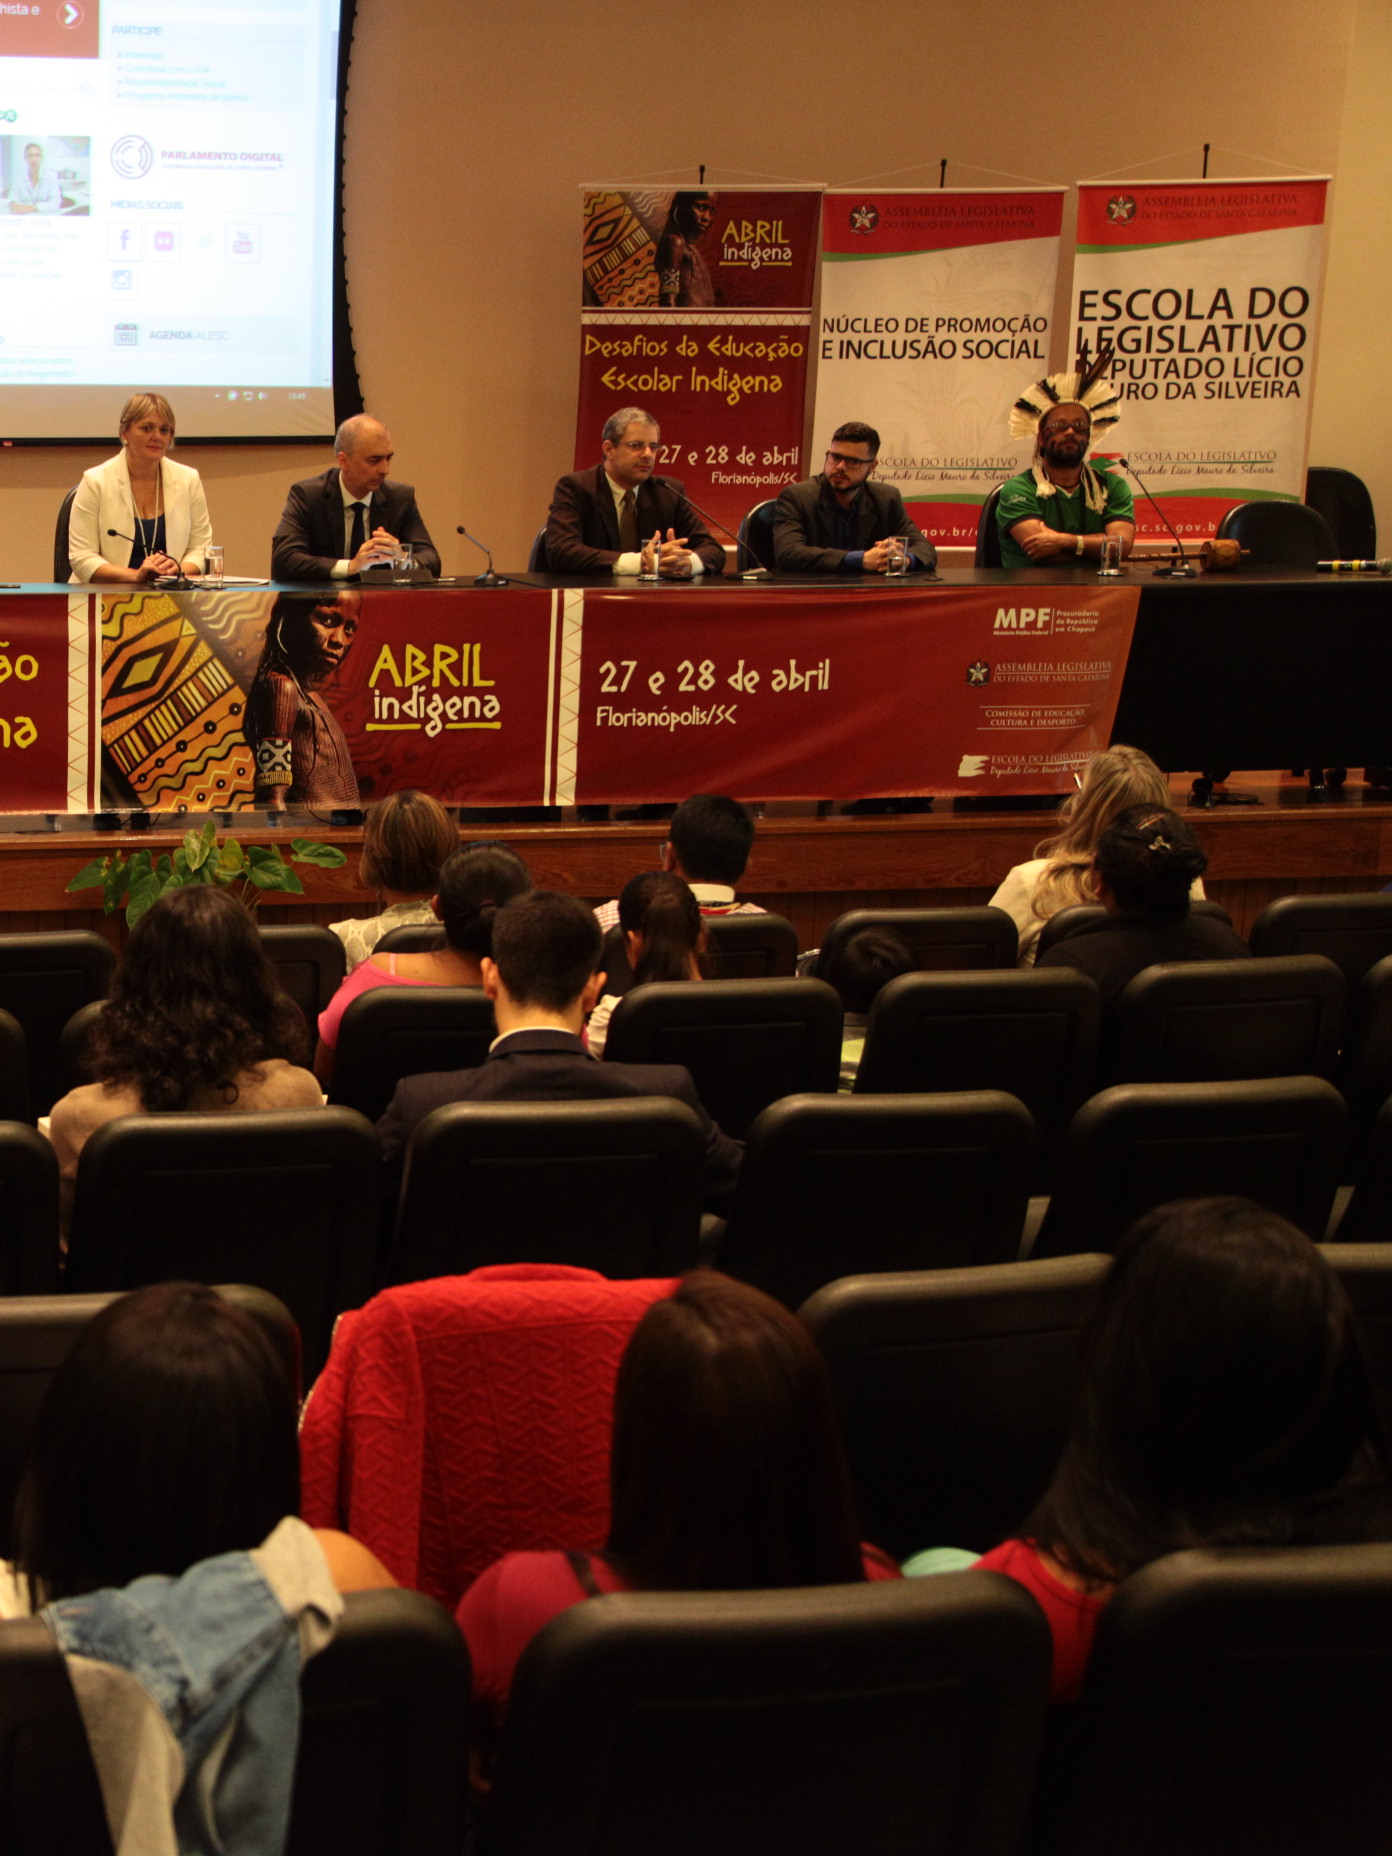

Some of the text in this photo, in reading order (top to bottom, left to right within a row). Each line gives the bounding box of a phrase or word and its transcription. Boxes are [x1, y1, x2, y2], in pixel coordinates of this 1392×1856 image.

[31, 6, 40, 14] e
[112, 25, 163, 36] PARTICIPE
[160, 150, 284, 162] PARLAMENTO DIGITAL
[110, 199, 184, 210] MÍDIAS SOCIAIS
[1144, 194, 1297, 207] ASSEMBLEIA LEGISLATIVA
[884, 205, 1036, 217] ASSEMBLEIA LEGISLATIVA
[1141, 211, 1156, 220] DO
[1201, 210, 1214, 219] DE
[1216, 209, 1246, 218] SANTA
[1248, 208, 1297, 218] CATARINA
[883, 221, 898, 230] DO
[940, 220, 953, 229] DE
[955, 220, 985, 229] SANTA
[986, 220, 1036, 228] CATARINA
[721, 219, 790, 244] ABRIL
[723, 242, 792, 270] indígena
[1078, 286, 1309, 321] ESCOLA DO
[822, 314, 1048, 336] NÚCLEO DE PROMOÇÃO
[149, 329, 230, 341] AGENDA ALESC
[1076, 323, 1307, 354] LEGISLATIVO
[584, 334, 804, 361] Desafios da Educação
[821, 335, 1046, 359] E INCLUSÃO SOCIAL
[1233, 352, 1304, 379] LÍCIO
[601, 366, 682, 392] Escolar
[1165, 382, 1197, 400] DA
[1204, 380, 1301, 400] SILVEIRA
[659, 445, 799, 466] 27 e 28 de abril
[1126, 450, 1277, 462] ESCOLA DO LEGISLATIVO
[879, 457, 1018, 467] SCOLA DO LEGISLATIVO
[1226, 464, 1238, 475] da
[1241, 464, 1275, 475] Silveira
[711, 471, 797, 488] Florianópolis/SC
[872, 470, 912, 482] Deputado
[970, 470, 980, 480] da
[993, 608, 1051, 629] MPF
[1066, 618, 1098, 626] República
[1066, 626, 1096, 634] Chapecó
[369, 643, 496, 688] ABRIL
[995, 661, 1111, 672] ASSEMBLEIA LEGISLATIVA
[599, 658, 831, 694] 27 e 28 de abril
[1008, 674, 1038, 682] ESTADO
[1039, 674, 1050, 682] DE
[1052, 674, 1076, 682] SANTA
[1077, 673, 1110, 681] CATARINA
[373, 684, 500, 737] indígena
[986, 708, 1085, 718] COMISSÃO DE EDUCAÇÃO
[596, 704, 737, 733] Florianópolis/SC
[1037, 718, 1076, 726] DESPORTO
[992, 755, 1026, 764] ESCOLA
[1029, 755, 1043, 764] DO
